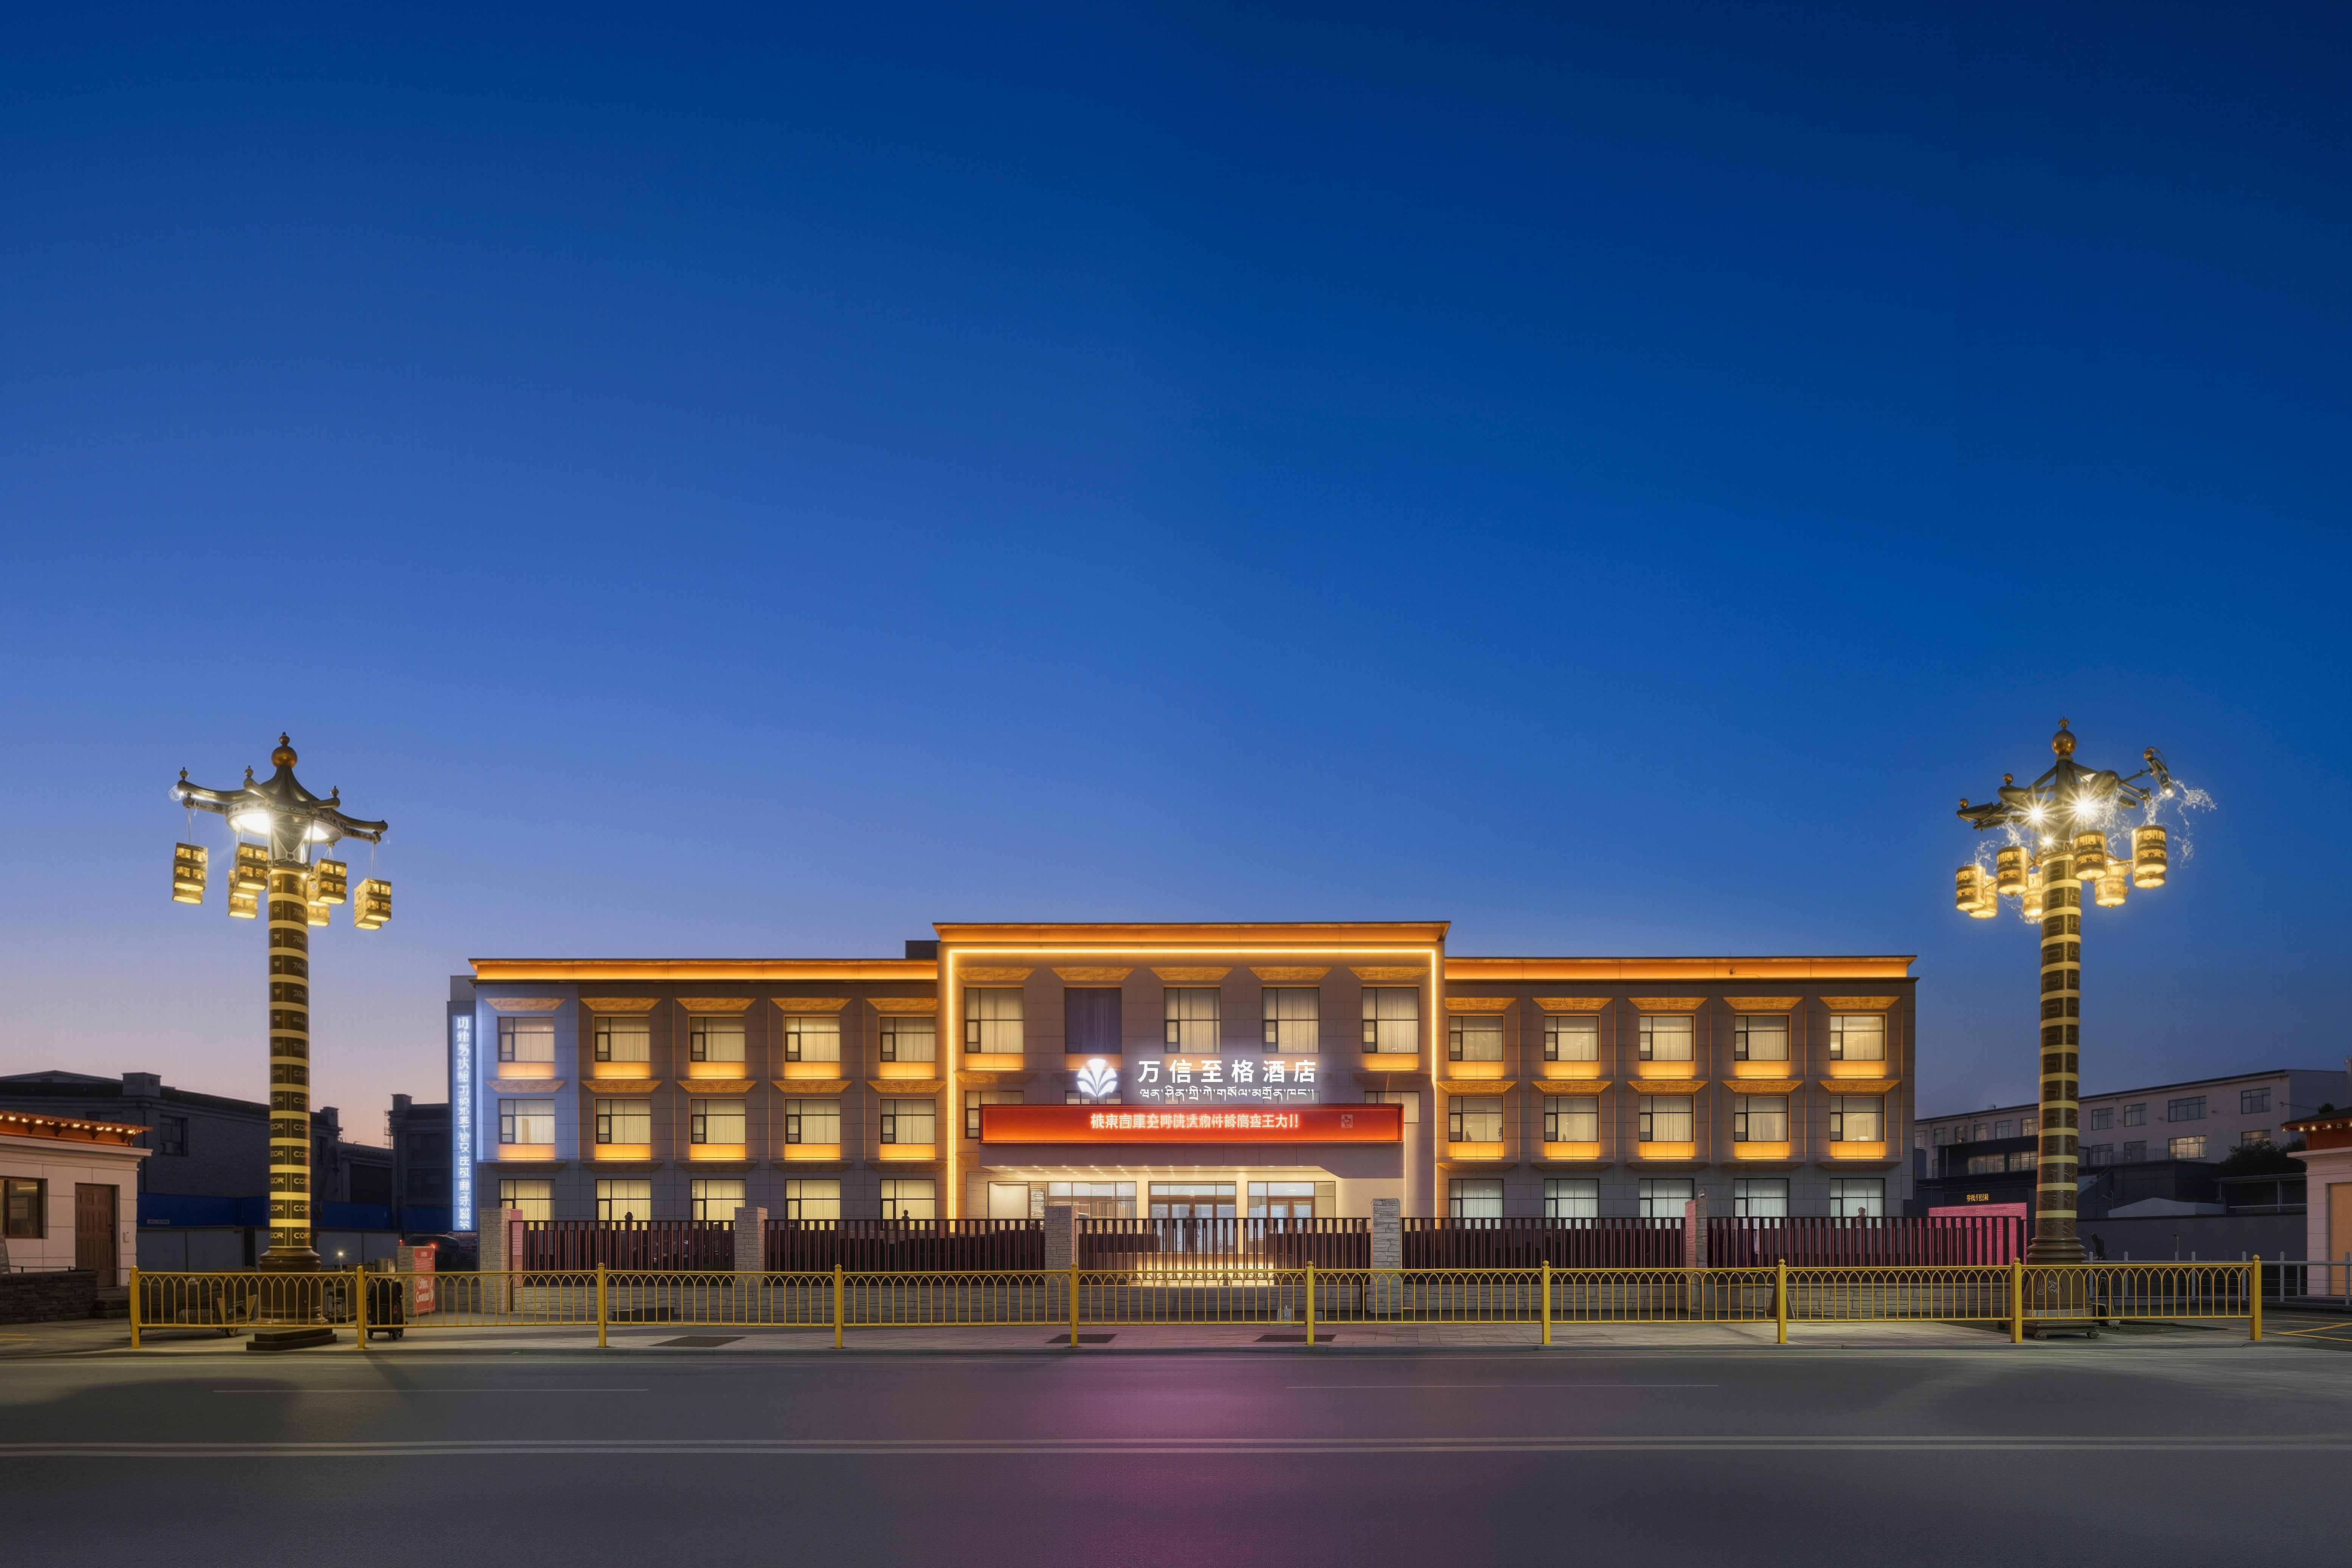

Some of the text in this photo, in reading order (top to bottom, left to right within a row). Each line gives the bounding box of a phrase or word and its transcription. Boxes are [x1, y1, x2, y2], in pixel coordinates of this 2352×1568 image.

[1137, 1059, 1316, 1083] 万信至格酒店
